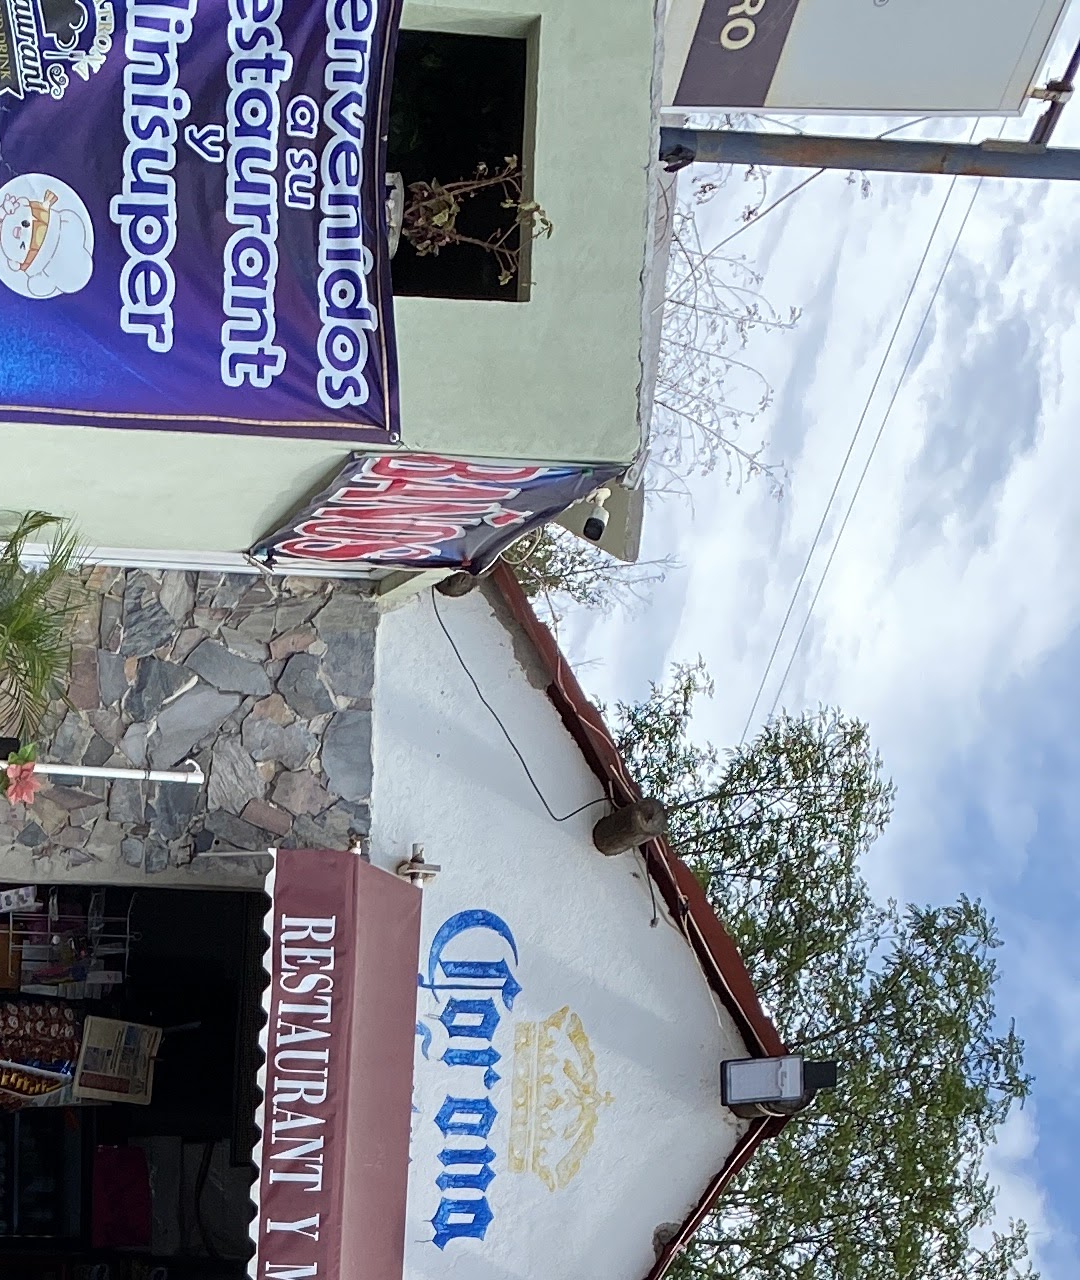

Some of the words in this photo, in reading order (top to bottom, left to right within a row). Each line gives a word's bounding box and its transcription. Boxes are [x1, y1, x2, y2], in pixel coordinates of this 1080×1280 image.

[186, 125, 224, 161] y
[286, 96, 319, 137] a
[110, 0, 198, 352] inisuper
[284, 149, 317, 209] su
[272, 455, 548, 560] BAÑOS
[270, 915, 337, 1192] RESTAURANT
[417, 909, 523, 1252] Corona
[265, 1213, 320, 1241] Y
